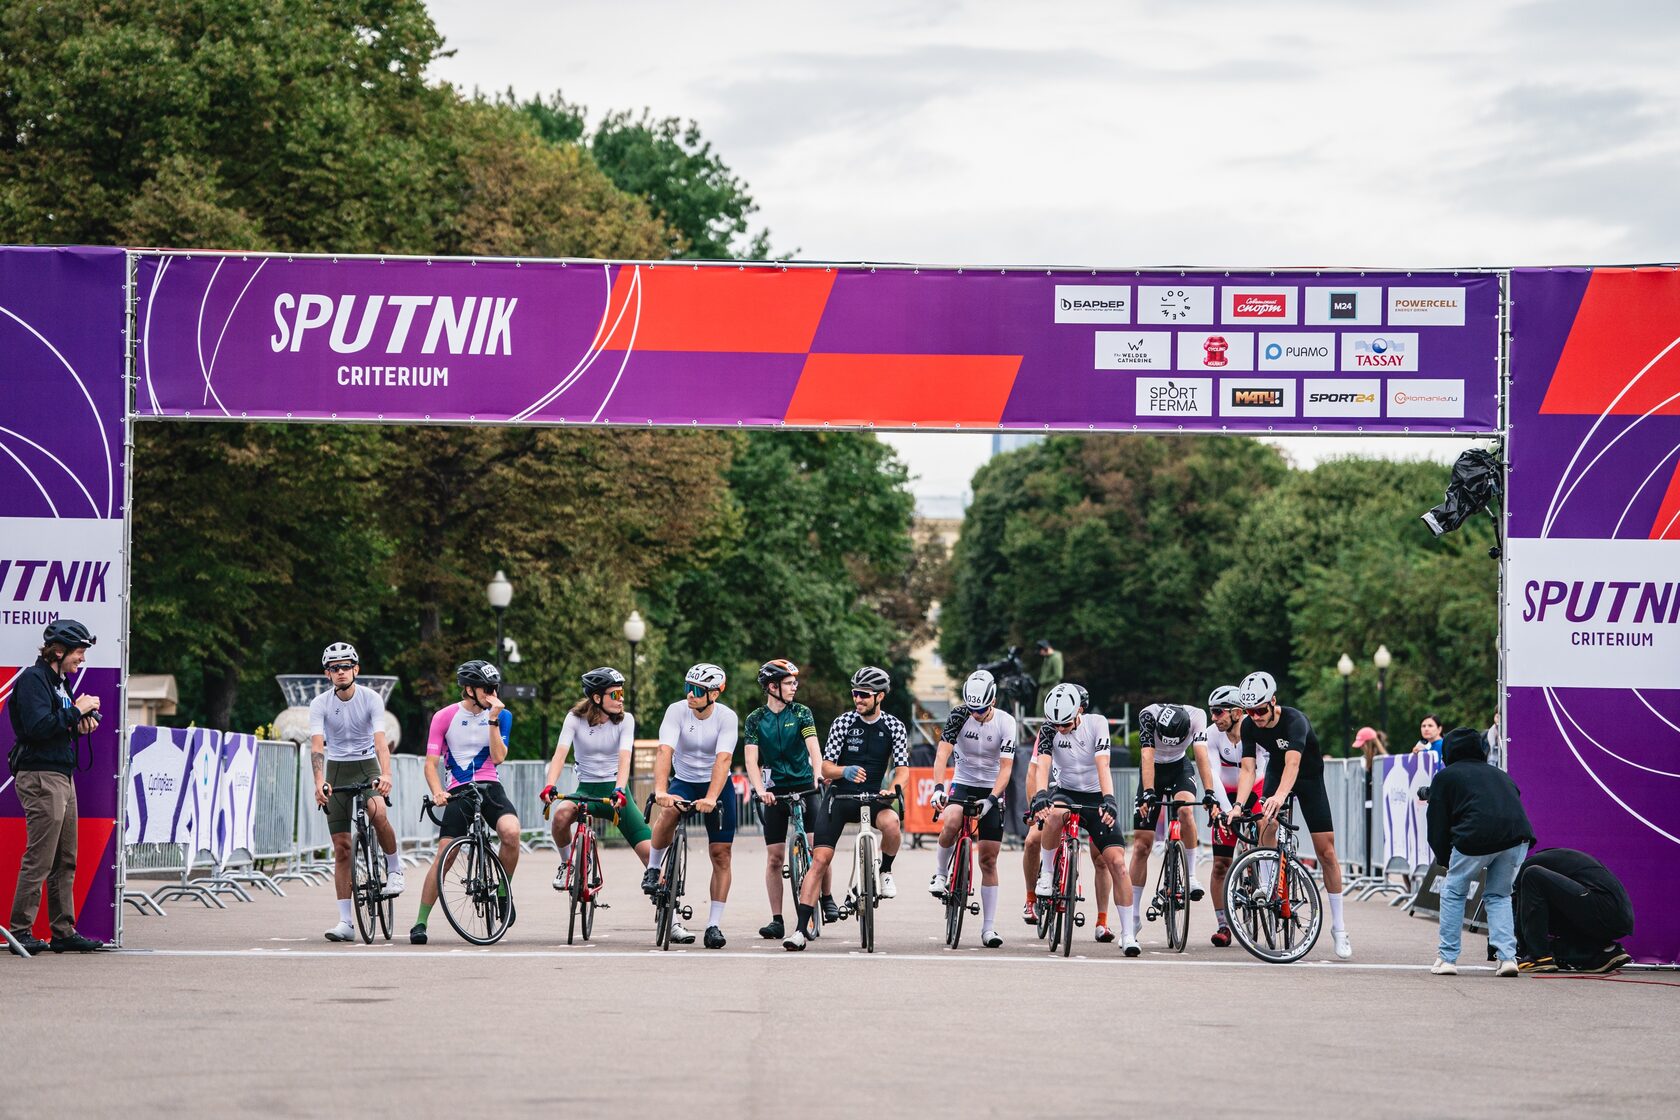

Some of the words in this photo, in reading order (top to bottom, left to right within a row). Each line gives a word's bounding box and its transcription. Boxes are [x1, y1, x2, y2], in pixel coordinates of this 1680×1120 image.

[1073, 300, 1125, 308] БАРЬЕР
[1334, 302, 1353, 310] M24
[1395, 299, 1458, 308] POWERCELL
[270, 292, 519, 356] SPUTNIK
[1355, 355, 1405, 367] TASSAY
[337, 365, 449, 387] CRITERIUM
[1150, 386, 1198, 399] SPORT
[1309, 393, 1375, 403] SPORT24
[1150, 400, 1198, 411] FERMA
[0, 611, 59, 625] TERIUM
[1571, 631, 1653, 647] CRITERIUM
[967, 694, 982, 704] 036
[1242, 693, 1256, 701] 023
